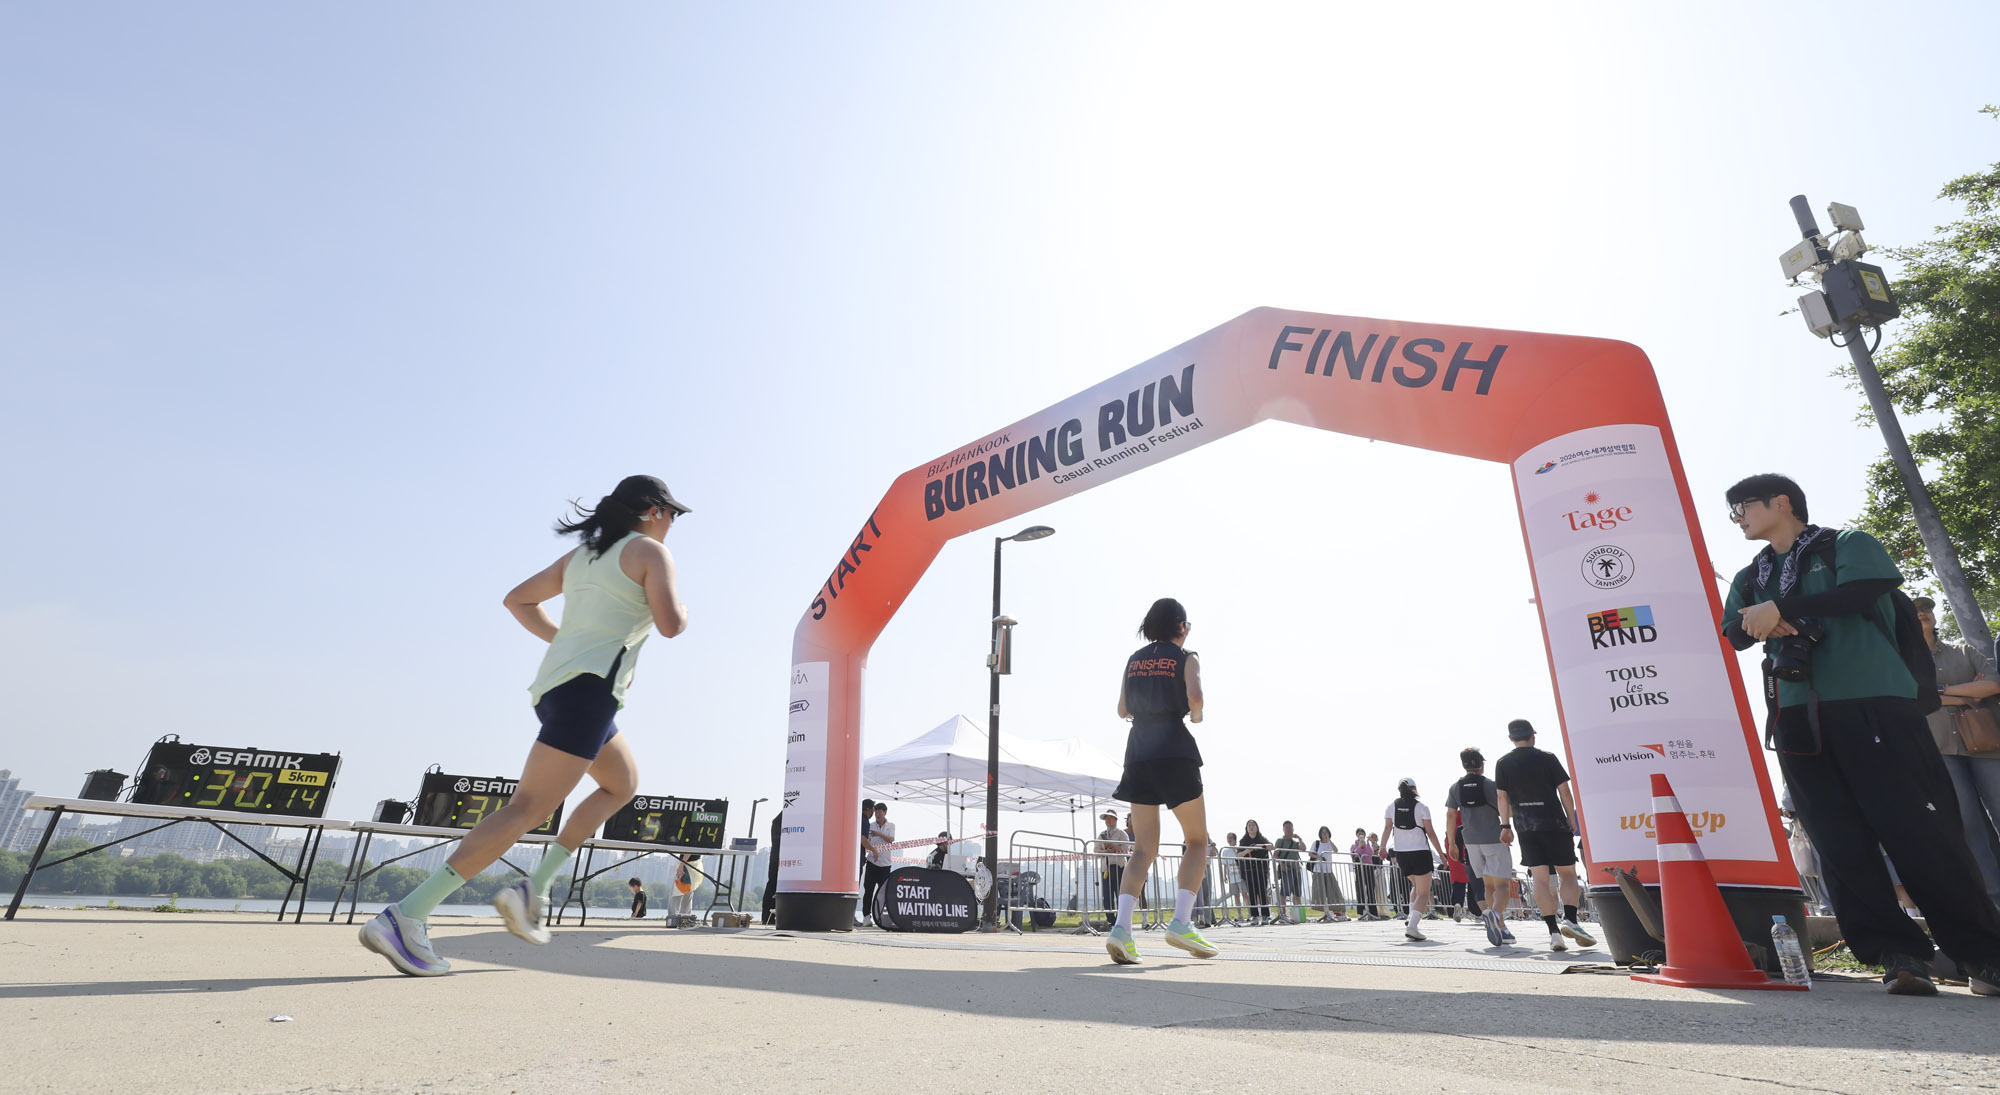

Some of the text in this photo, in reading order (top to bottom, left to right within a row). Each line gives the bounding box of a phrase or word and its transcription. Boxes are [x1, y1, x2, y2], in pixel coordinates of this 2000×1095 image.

[1268, 325, 1509, 396] FINISH
[924, 363, 1195, 521] BURNING RUN
[1052, 417, 1204, 484] Casual Running Festival
[1562, 506, 1633, 531] Tage
[811, 507, 882, 621] START
[1586, 547, 1625, 564] SUNBODY
[1594, 574, 1627, 587] TANNING
[1591, 624, 1657, 650] KIND
[1128, 658, 1177, 672] FINISHER
[1605, 665, 1657, 682] TOUS
[1626, 681, 1643, 693] les
[1767, 676, 1775, 698] Canon
[1610, 691, 1669, 712] JOURS
[213, 751, 304, 769] SAMIK
[1595, 751, 1654, 765] World Vision
[288, 771, 318, 783] 5km
[472, 780, 519, 795] SAM
[649, 799, 706, 812] SAMIK
[695, 812, 719, 822] 10km
[896, 884, 931, 900] START
[897, 902, 969, 918] WAITING LINE
